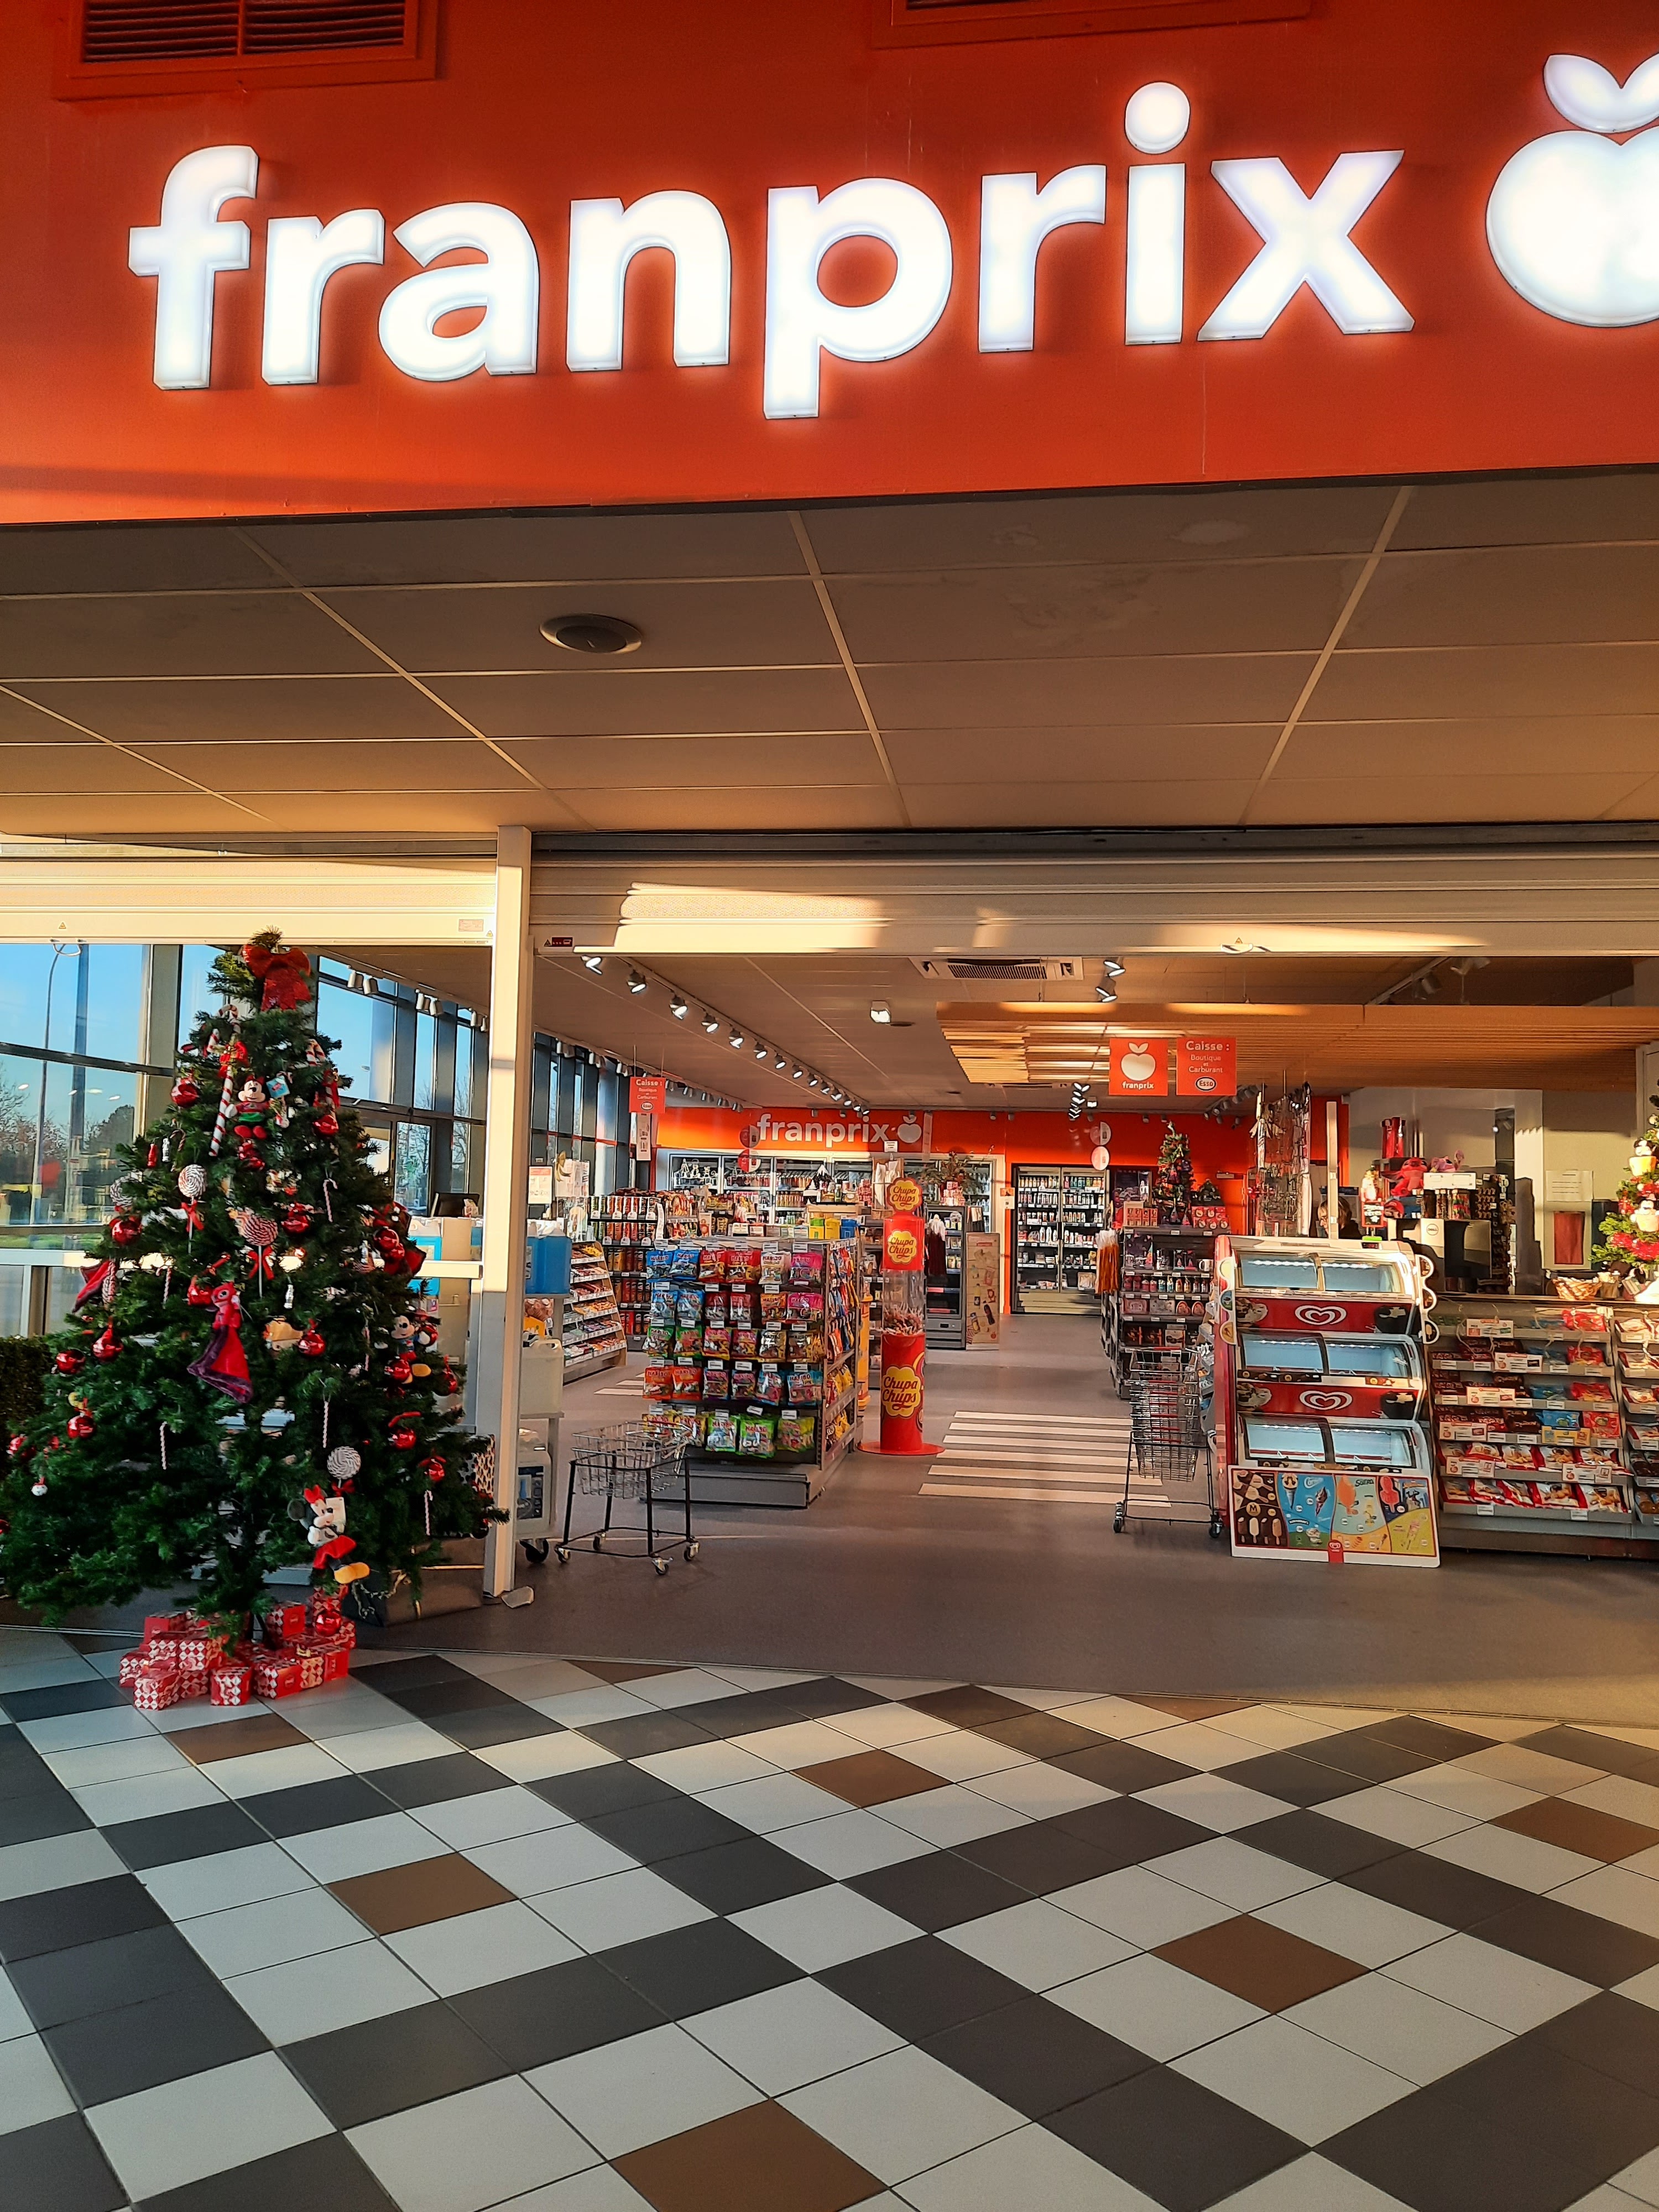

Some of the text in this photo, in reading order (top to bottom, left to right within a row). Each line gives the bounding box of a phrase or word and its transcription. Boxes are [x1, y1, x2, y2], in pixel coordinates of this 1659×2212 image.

[128, 81, 1414, 420] franprix
[1186, 1041, 1223, 1051] Caisse
[1122, 1081, 1154, 1089] franprix
[757, 1114, 889, 1148] franprix
[893, 1186, 916, 1196] Chupa
[892, 1194, 915, 1207] Chups
[891, 1237, 914, 1248] Chupa
[889, 1245, 913, 1259] Chups
[884, 1376, 918, 1392] Chupa
[883, 1389, 916, 1410] Chups
